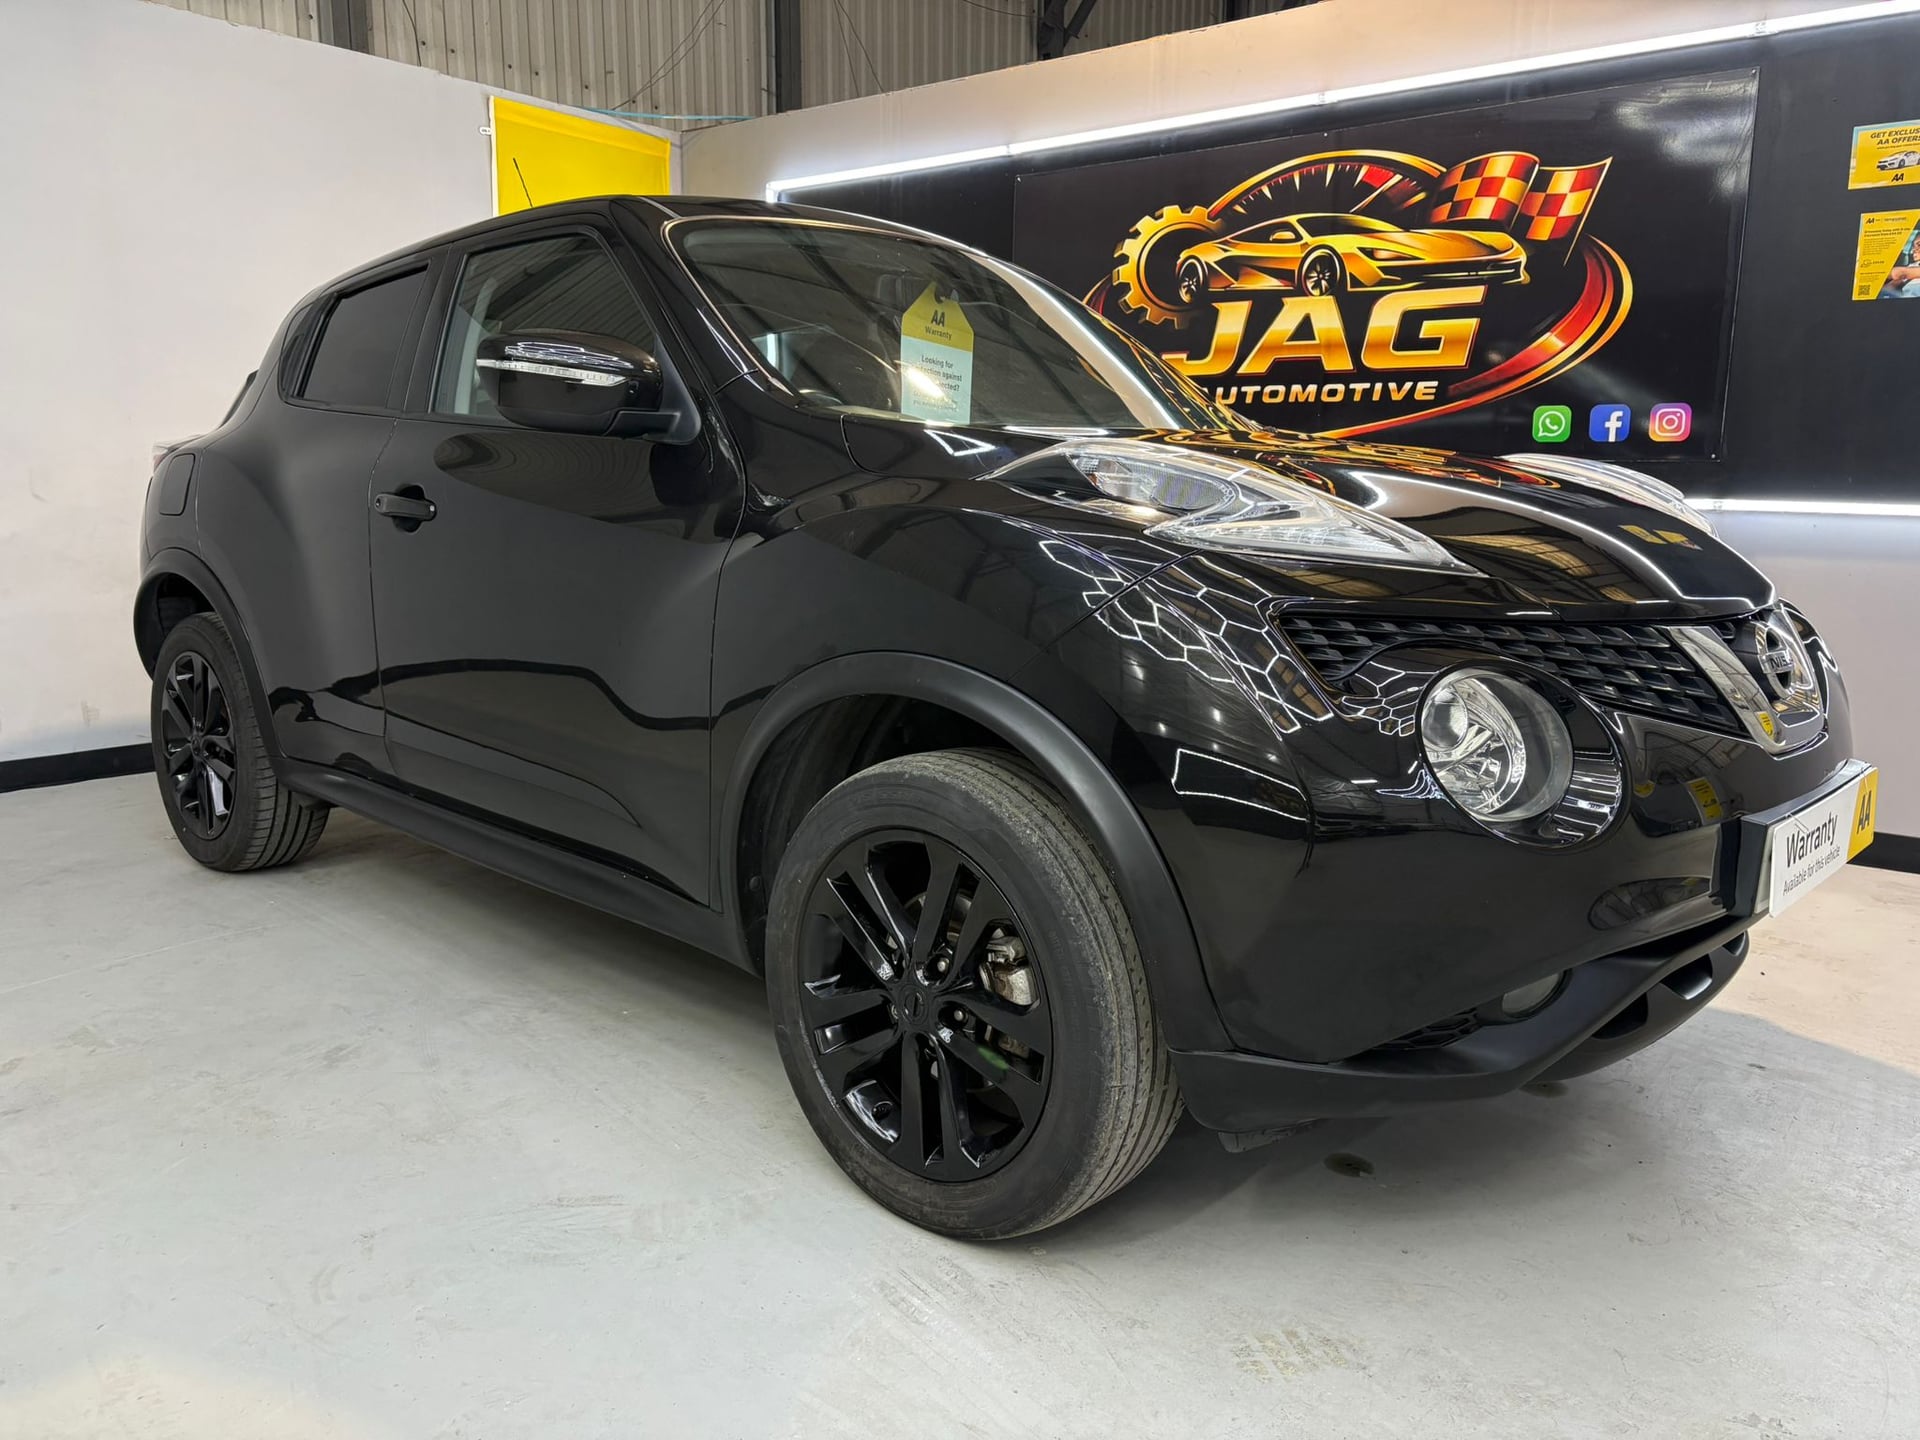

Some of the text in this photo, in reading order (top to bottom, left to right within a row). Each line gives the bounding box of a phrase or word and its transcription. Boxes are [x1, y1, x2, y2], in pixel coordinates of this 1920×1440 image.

[1870, 131, 1887, 139] GET
[1891, 173, 1904, 182] AA
[931, 309, 946, 327] AA
[924, 325, 952, 341] Warranty
[1162, 285, 1488, 376] JAG
[921, 354, 954, 369] Looking for
[942, 371, 963, 382] against
[1204, 380, 1438, 405] UTOMOTIVE
[1857, 790, 1872, 834] AA
[1786, 811, 1838, 868] Warranty
[1782, 845, 1841, 896] Available for this vehicle
